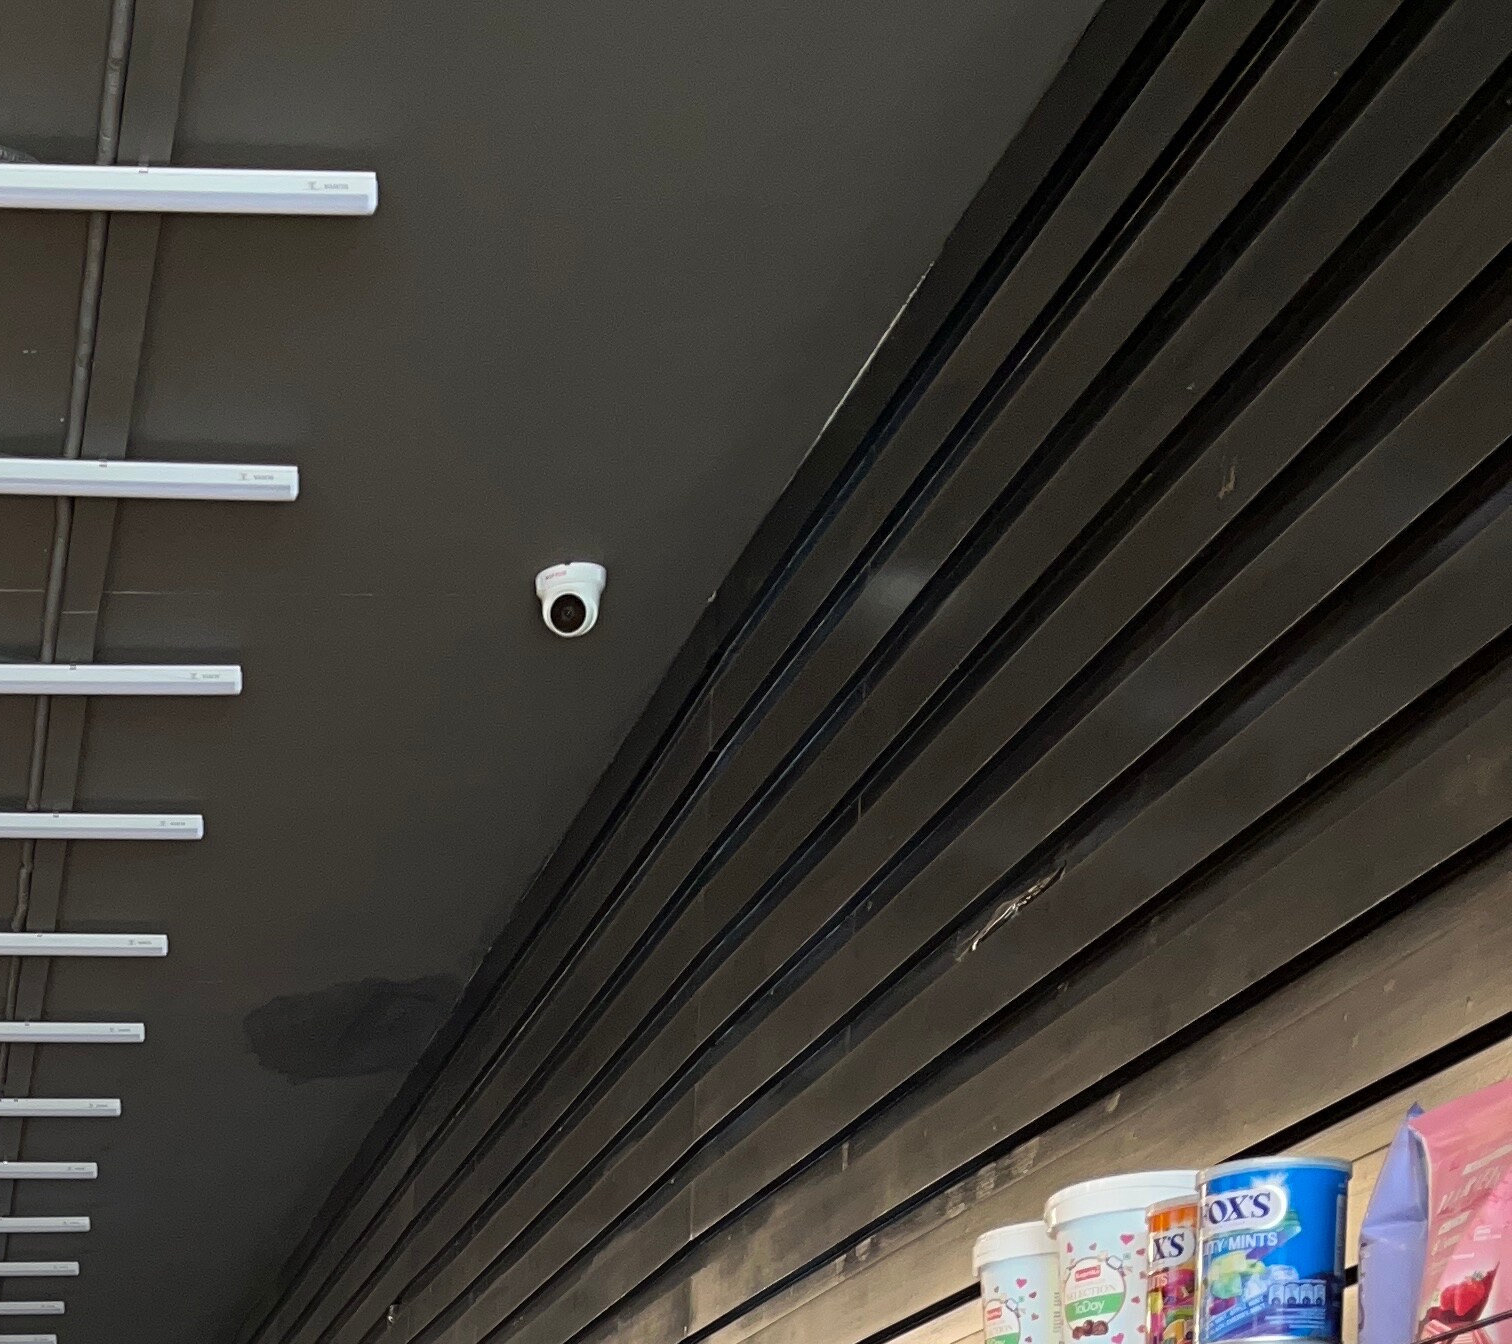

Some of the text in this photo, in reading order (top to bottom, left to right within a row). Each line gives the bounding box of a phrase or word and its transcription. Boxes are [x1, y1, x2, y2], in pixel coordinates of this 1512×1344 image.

[1203, 1191, 1272, 1225] OX'S
[1152, 1232, 1185, 1260] X'S
[1229, 1232, 1278, 1249] MINTS
